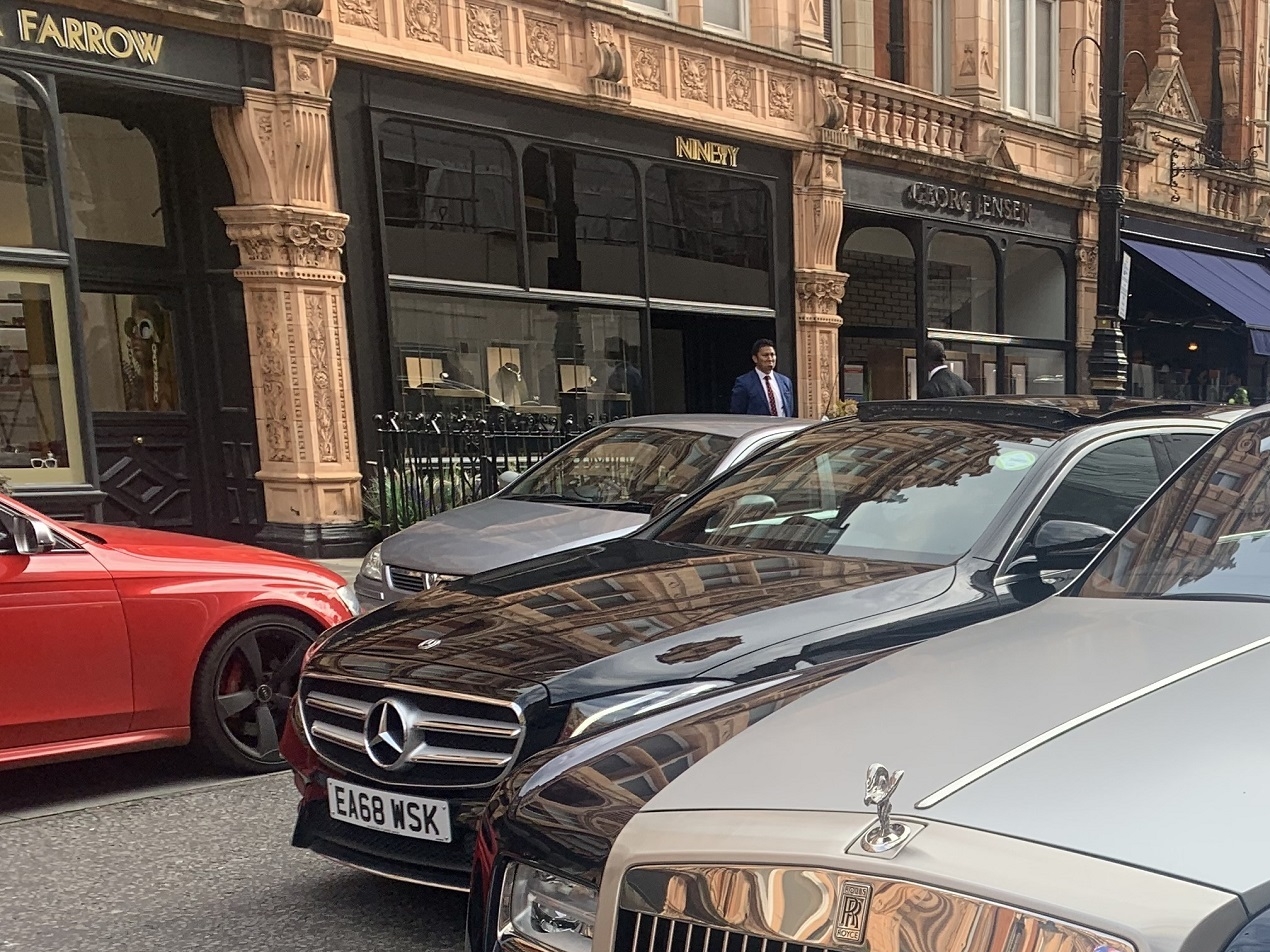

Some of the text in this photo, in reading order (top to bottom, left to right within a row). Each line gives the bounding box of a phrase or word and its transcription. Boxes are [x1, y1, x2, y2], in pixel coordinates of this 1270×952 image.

[17, 9, 164, 65] FARROW
[907, 181, 1033, 222] GEORG JENSEN
[334, 785, 440, 836] EA68 WSK
[837, 927, 859, 939] ROYCE
